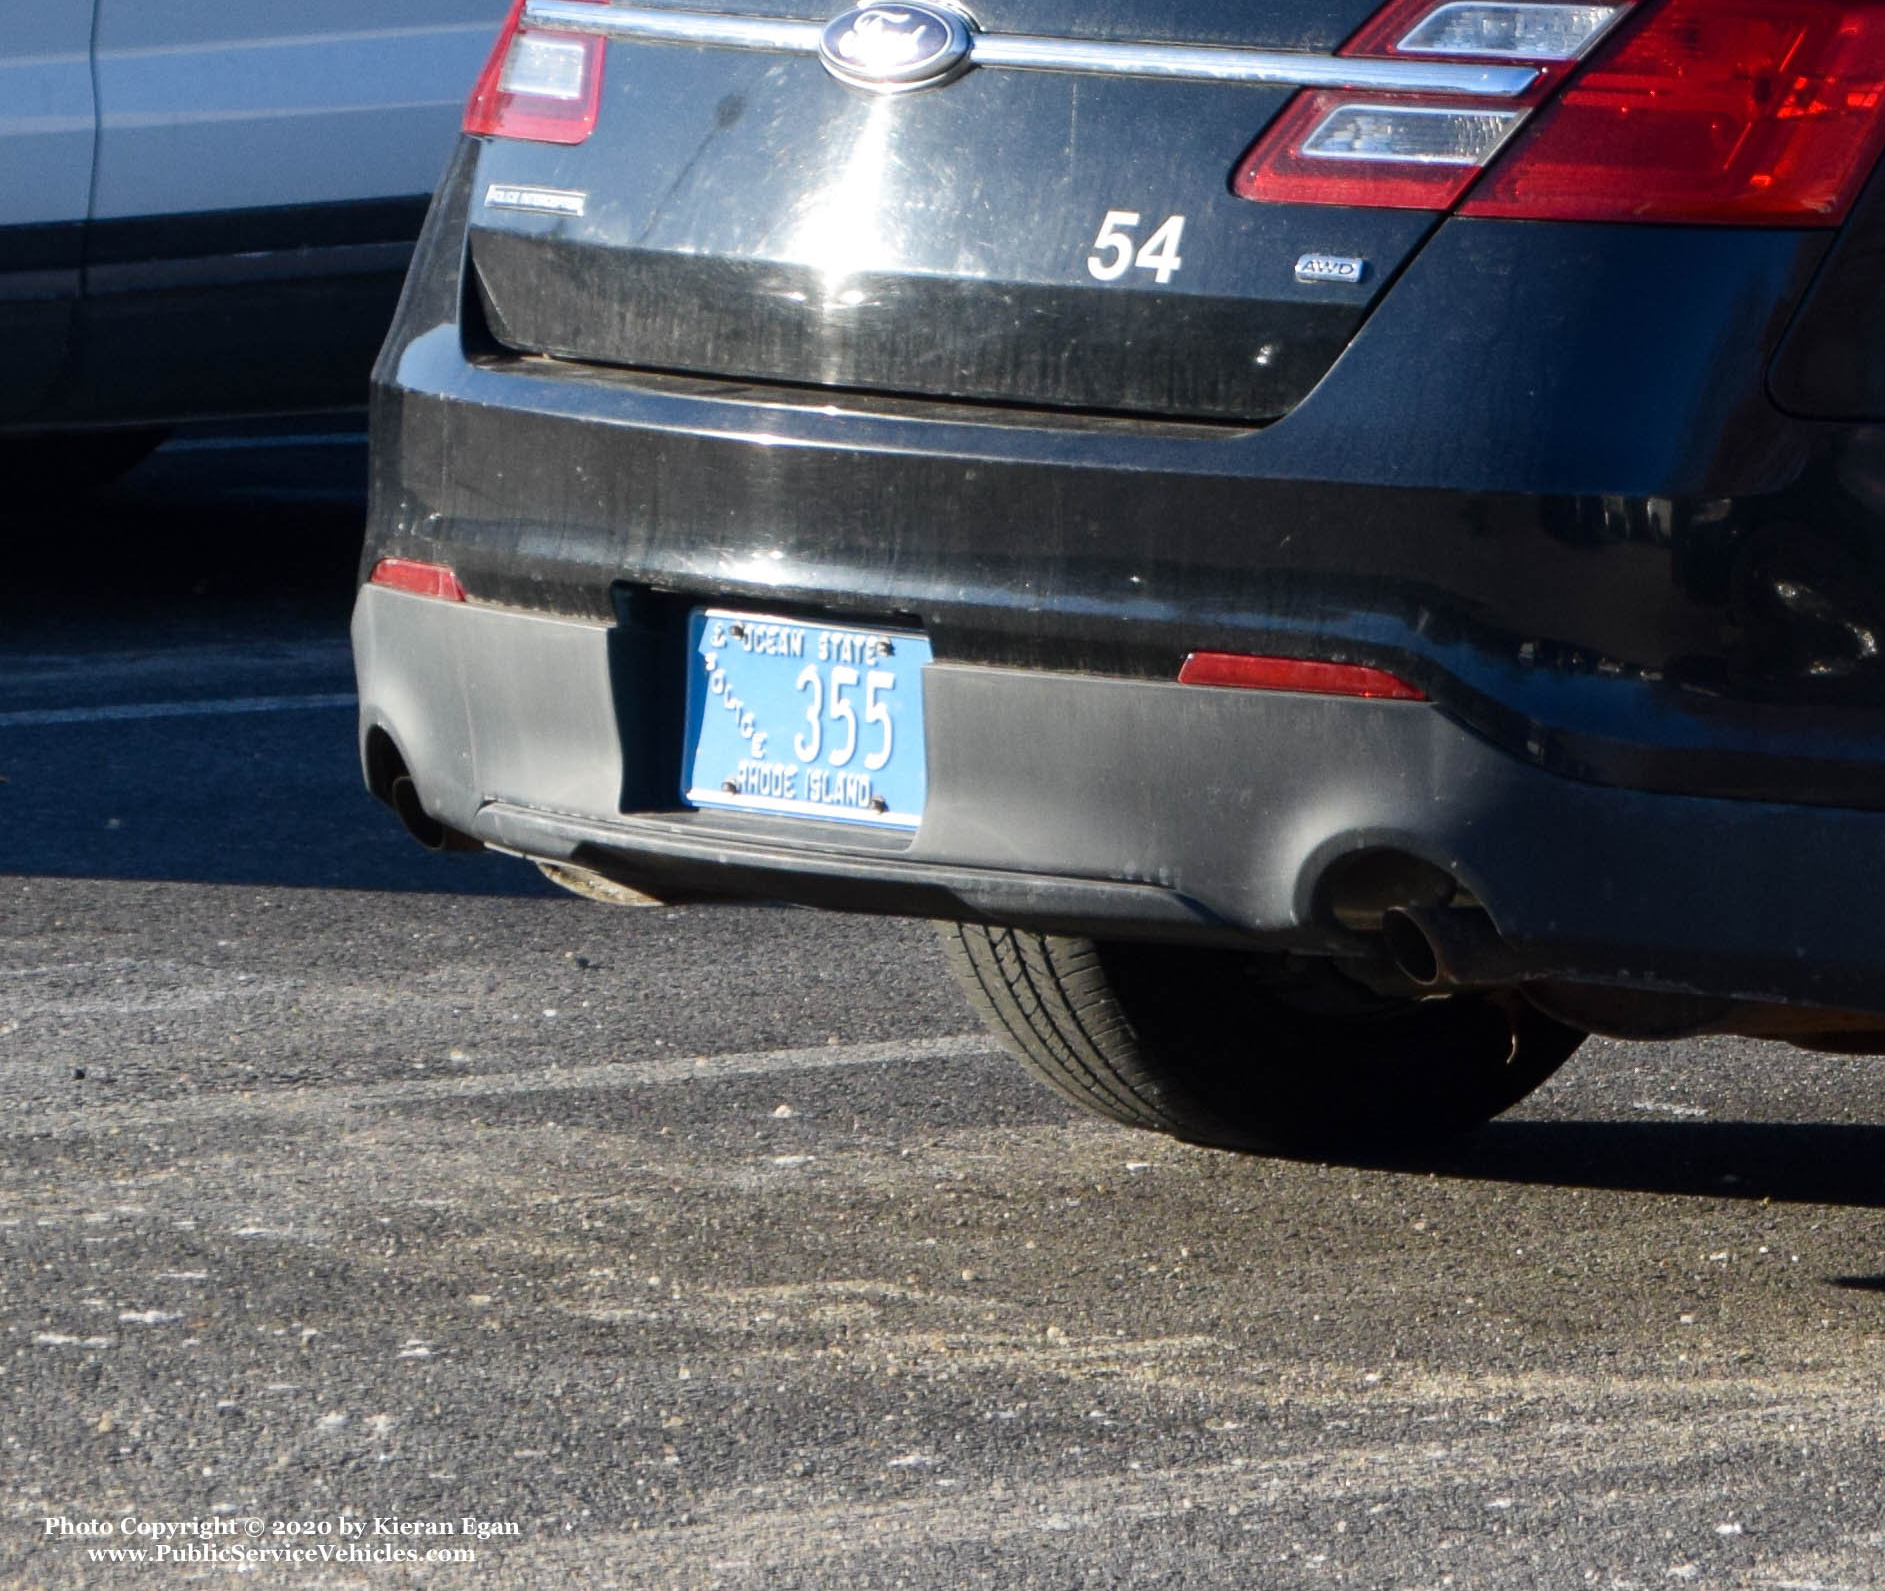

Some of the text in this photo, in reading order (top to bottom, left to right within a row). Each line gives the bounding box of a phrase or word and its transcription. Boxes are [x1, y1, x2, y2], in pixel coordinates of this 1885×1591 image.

[1087, 210, 1186, 284] 54
[1302, 260, 1355, 275] AWD
[743, 623, 882, 666] OCEAN STATE
[794, 663, 897, 772] 355
[736, 760, 873, 808] RHODE ISLAND
